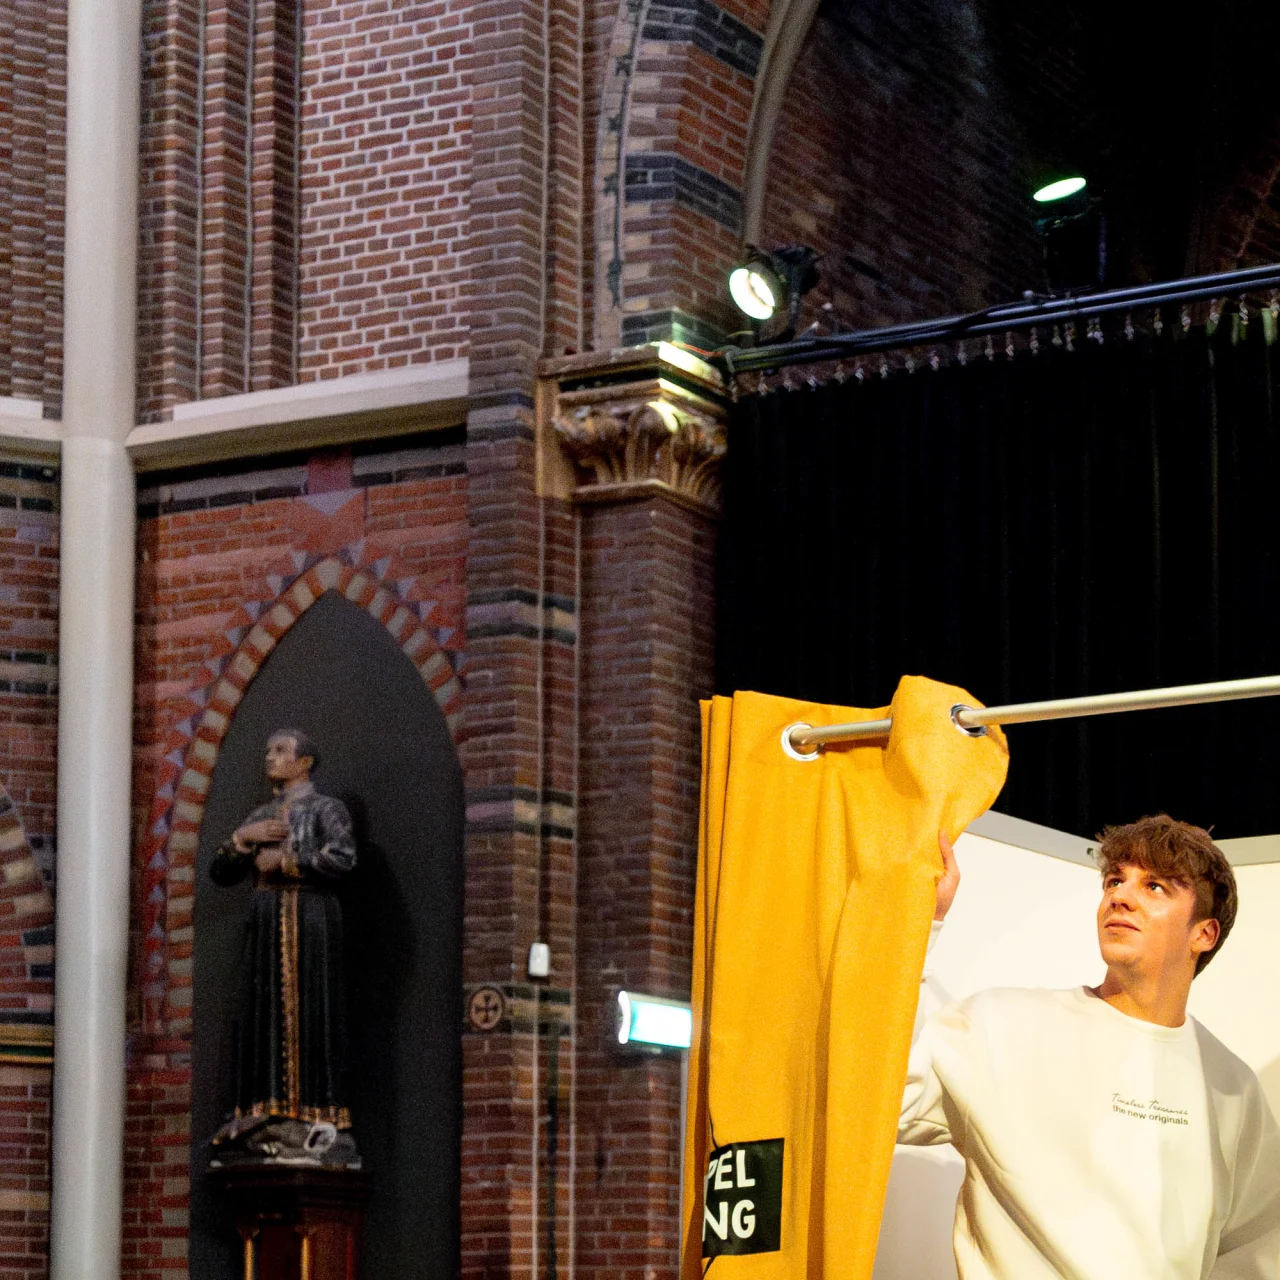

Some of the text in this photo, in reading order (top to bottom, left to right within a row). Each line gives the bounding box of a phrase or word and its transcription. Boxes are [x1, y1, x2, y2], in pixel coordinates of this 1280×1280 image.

[1112, 1104, 1189, 1125] the new originals
